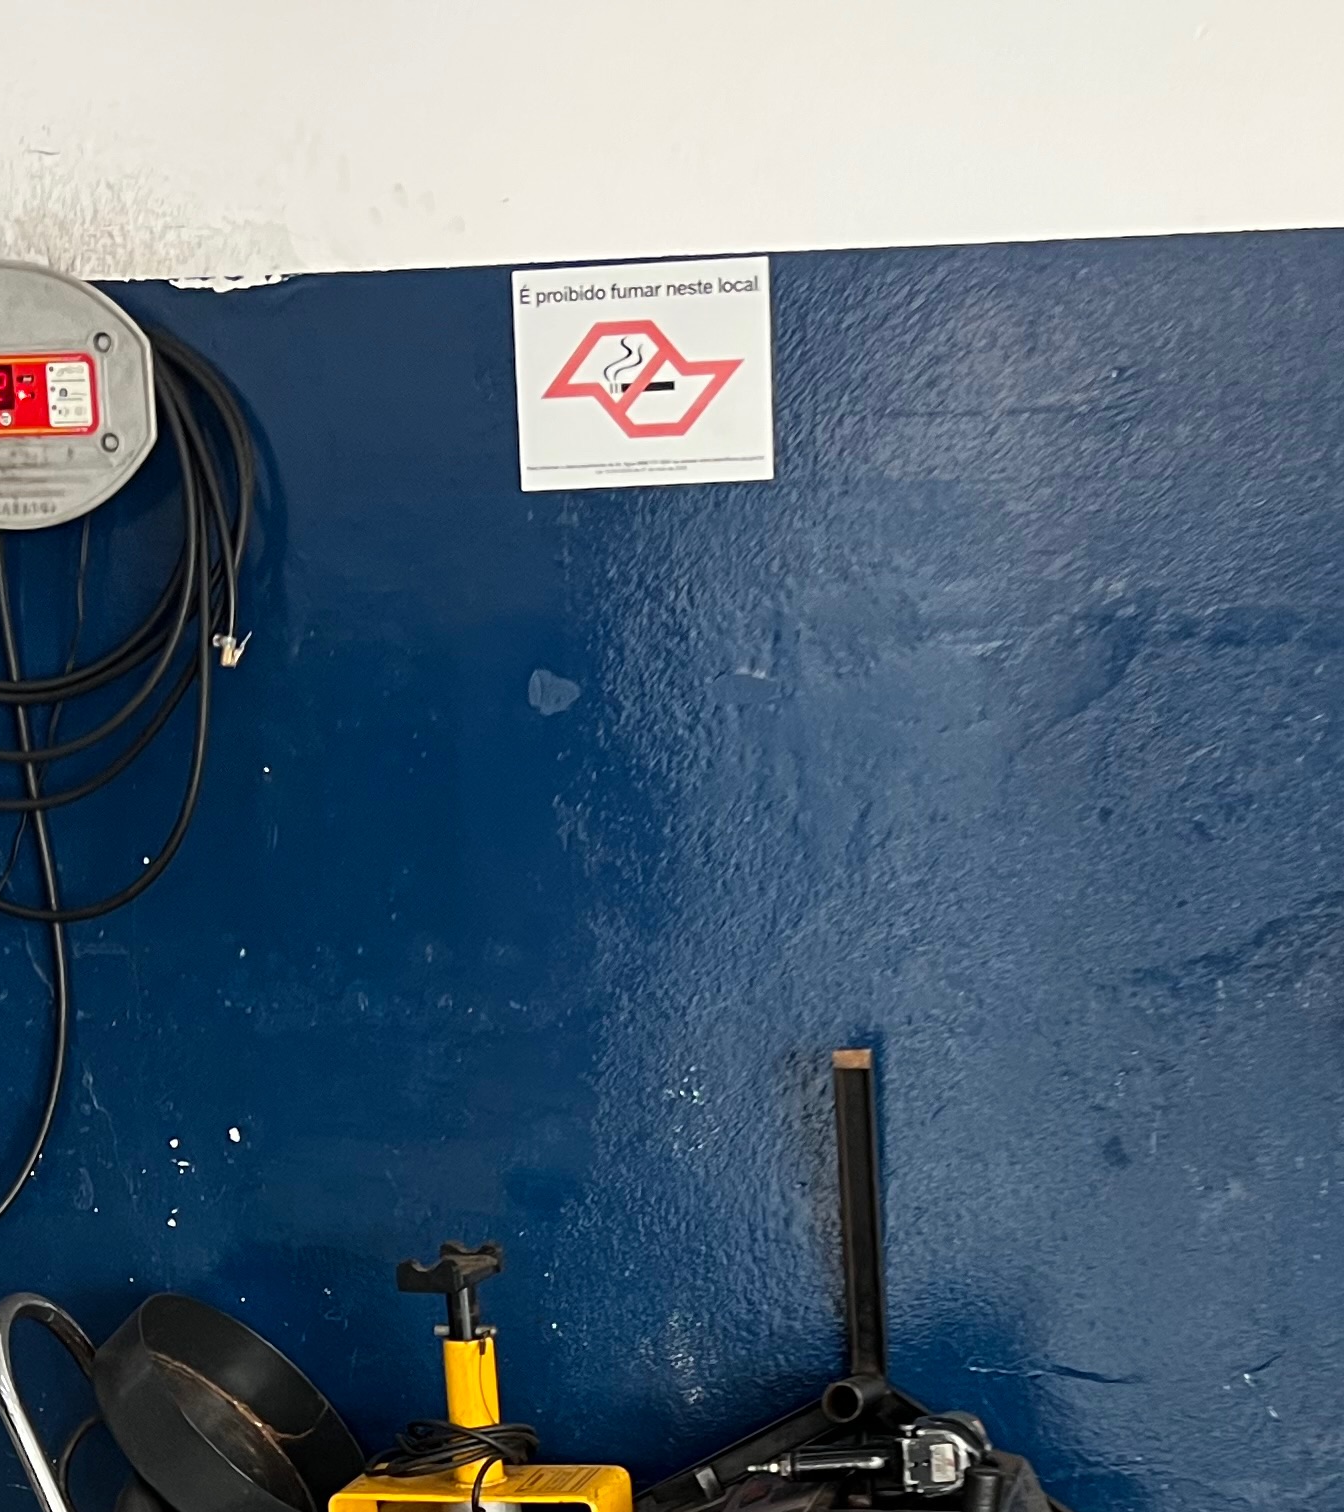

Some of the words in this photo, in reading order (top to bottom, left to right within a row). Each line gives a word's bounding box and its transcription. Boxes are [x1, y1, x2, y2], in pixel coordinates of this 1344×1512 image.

[519, 284, 531, 304] É
[536, 284, 606, 308] proibido
[610, 283, 662, 300] fumar
[666, 279, 713, 297] neste
[717, 274, 758, 293] local
